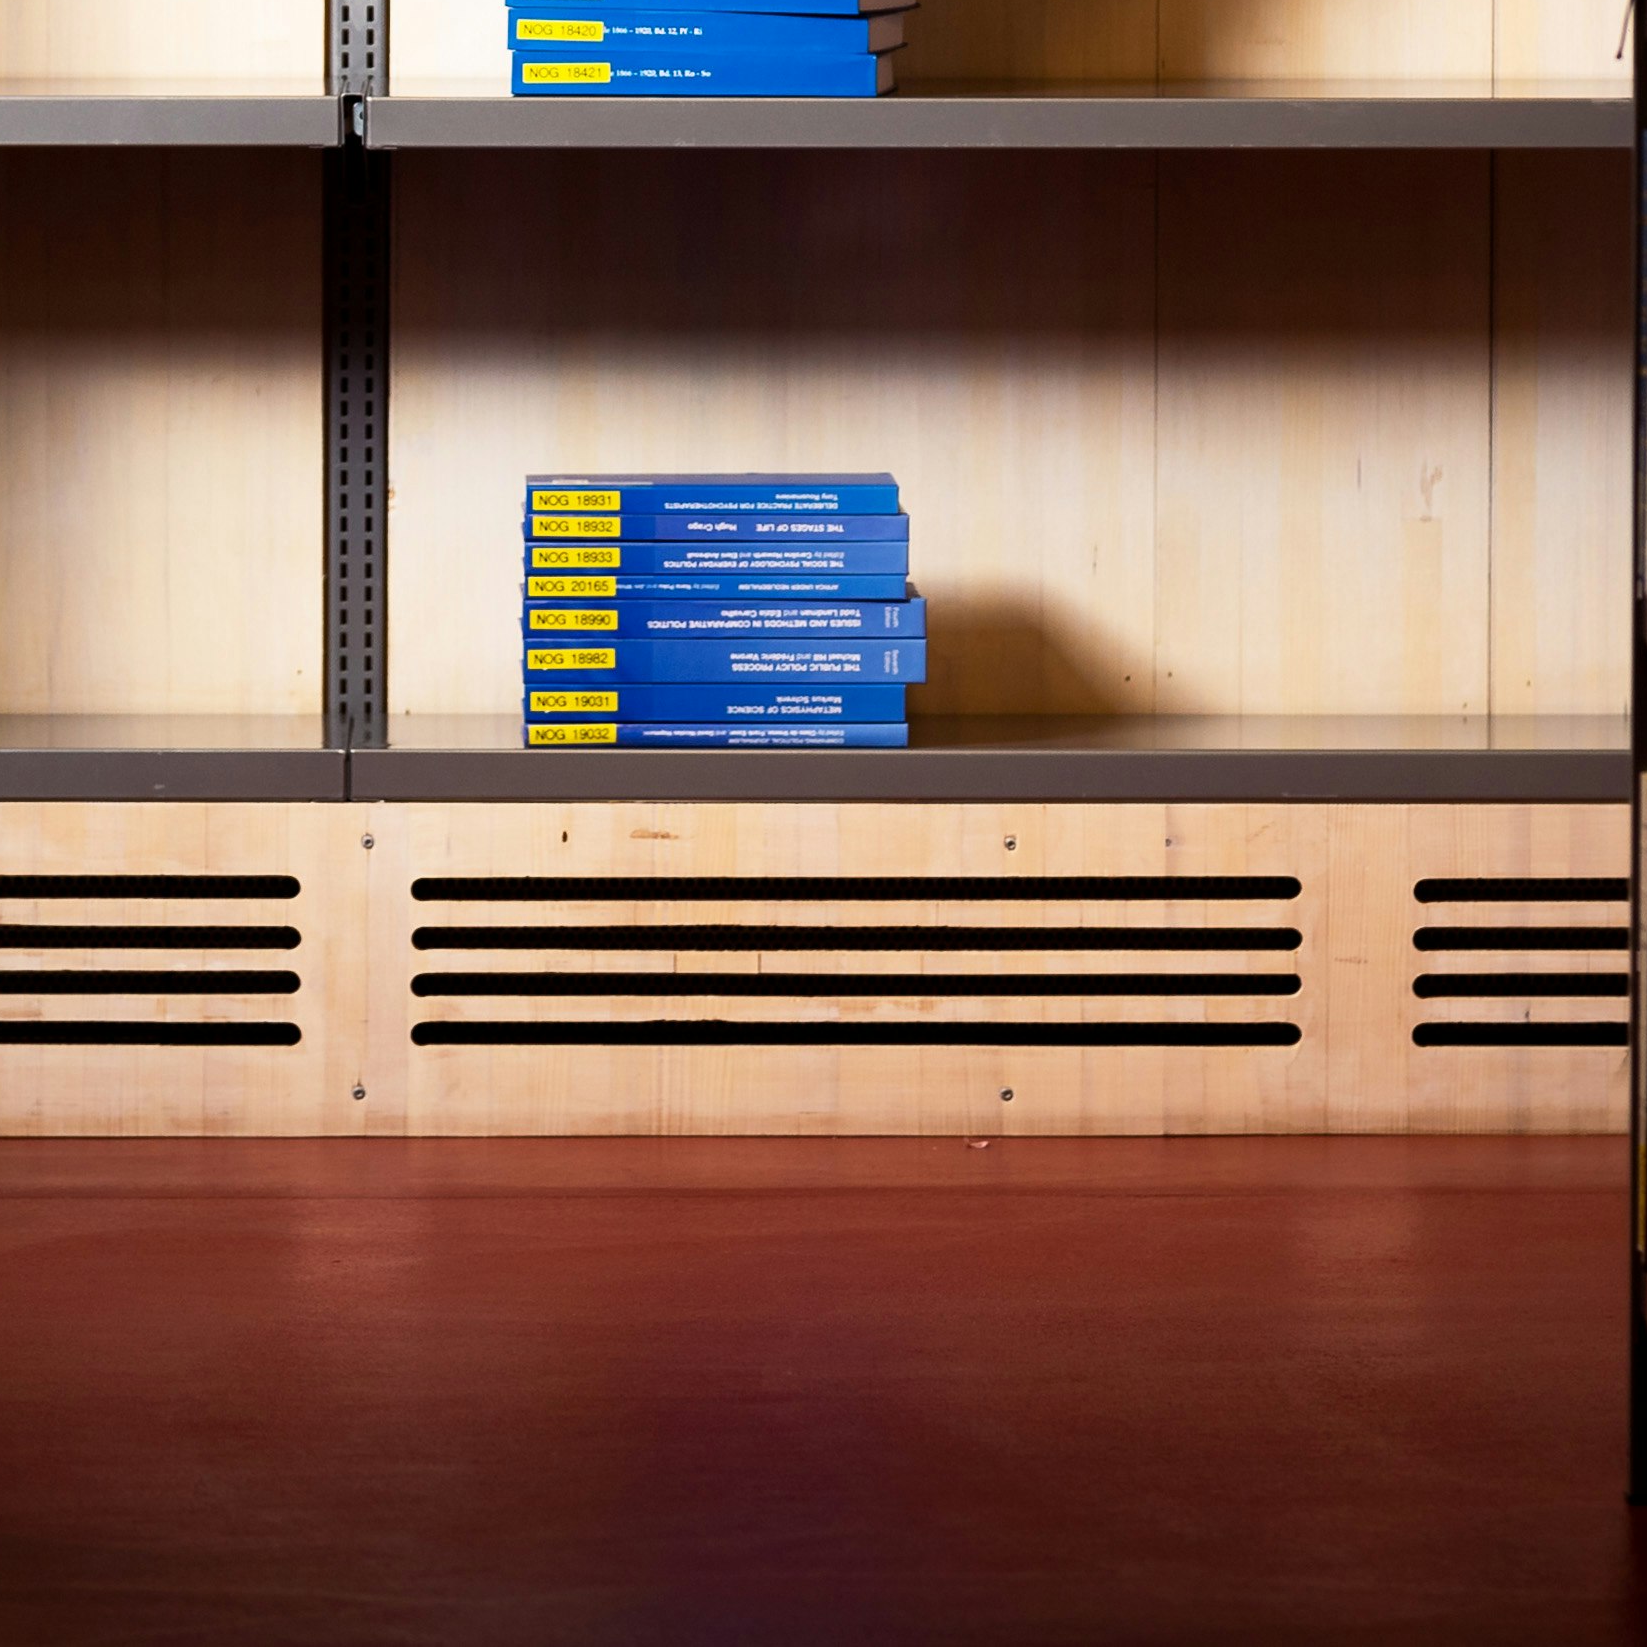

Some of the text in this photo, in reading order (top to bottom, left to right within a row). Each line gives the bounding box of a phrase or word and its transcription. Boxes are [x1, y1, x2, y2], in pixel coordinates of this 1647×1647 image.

[523, 23, 597, 37] NOG 18420
[529, 66, 602, 79] NOG 18421
[538, 494, 612, 507] NOG 18931
[539, 520, 613, 533] NOG 18932
[688, 522, 844, 533] THE STAGES OF LIFE Hugh Crago
[538, 551, 613, 564] NOG 18933
[534, 580, 609, 593] NOG 20165
[536, 613, 611, 626] NOG 18990
[534, 652, 565, 665] NOG
[732, 663, 860, 672] THE PUBLIC POLICY PROCESS
[536, 695, 610, 708] NOG 19031
[728, 706, 842, 714] METAPHYSICS OF SCIENCE
[535, 728, 610, 741] NOG 19032
